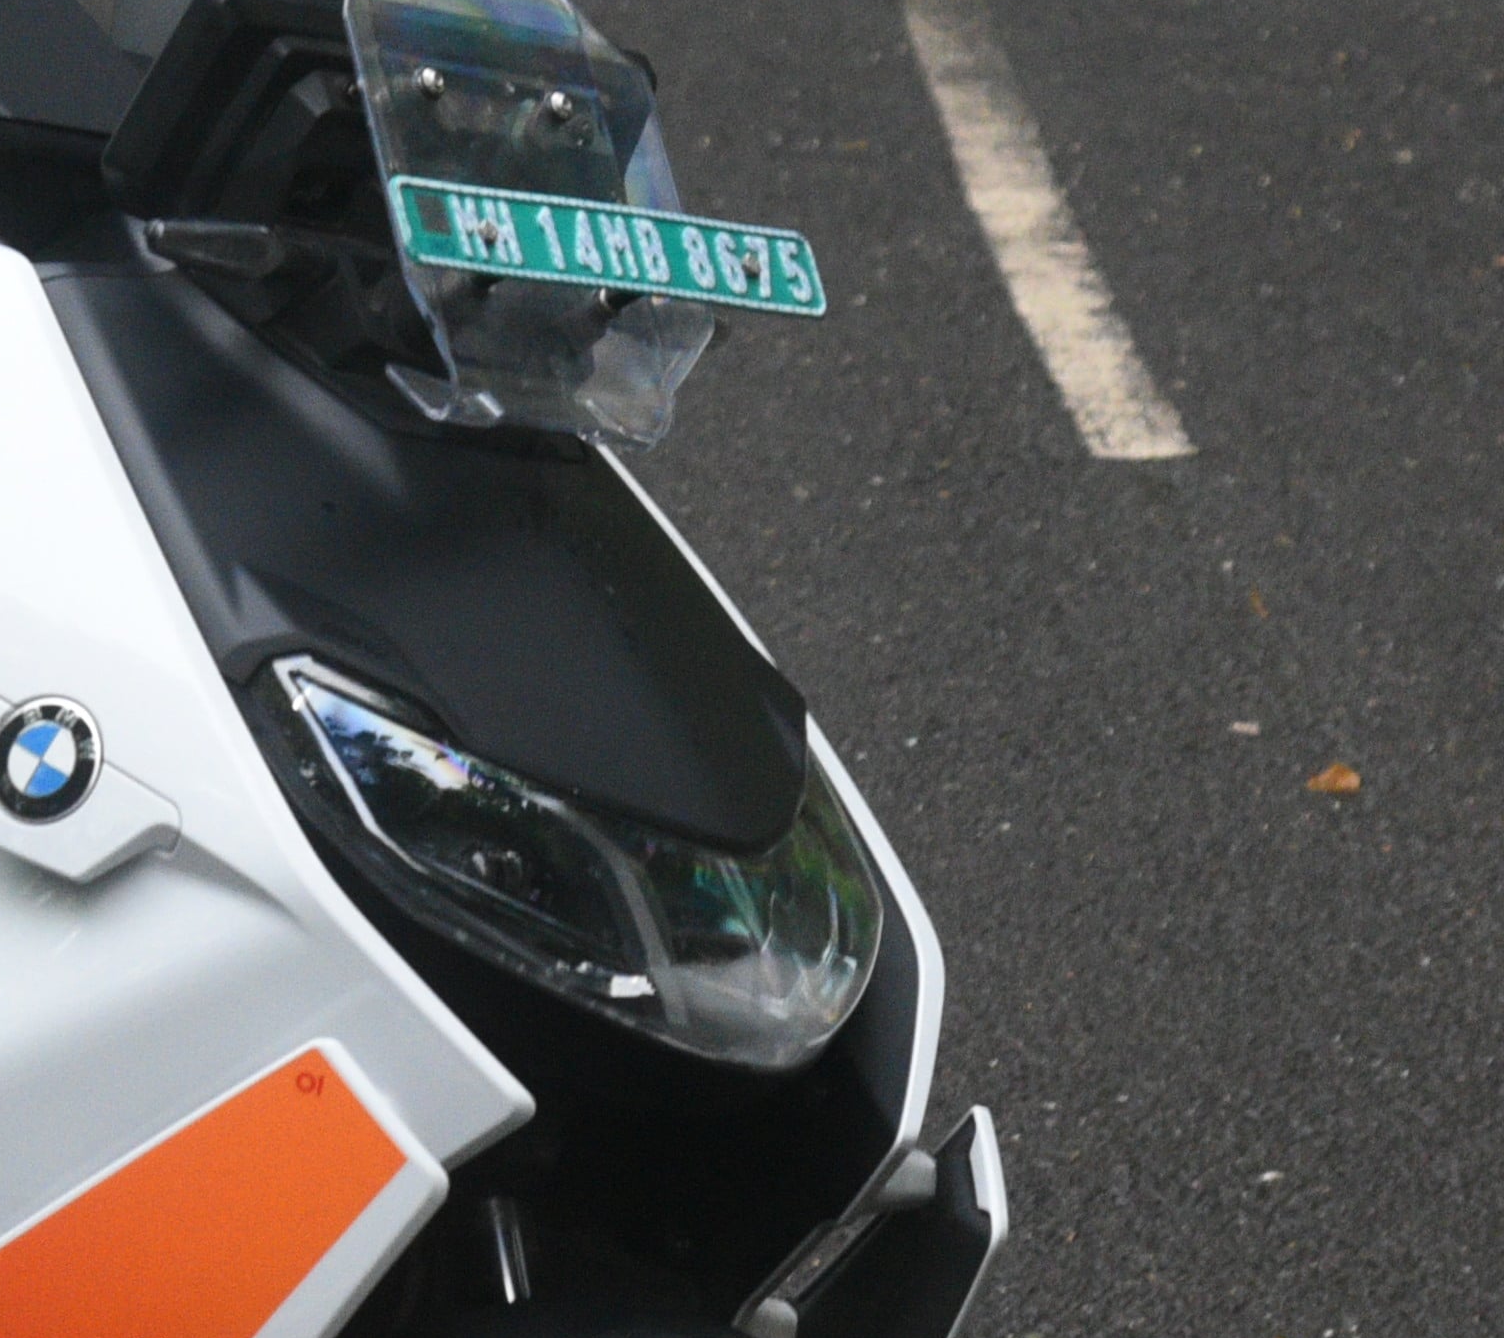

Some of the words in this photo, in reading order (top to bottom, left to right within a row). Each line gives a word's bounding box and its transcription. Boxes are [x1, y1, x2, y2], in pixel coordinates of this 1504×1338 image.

[447, 192, 523, 266] MH
[536, 205, 671, 284] 14MB
[682, 225, 814, 303] 8675
